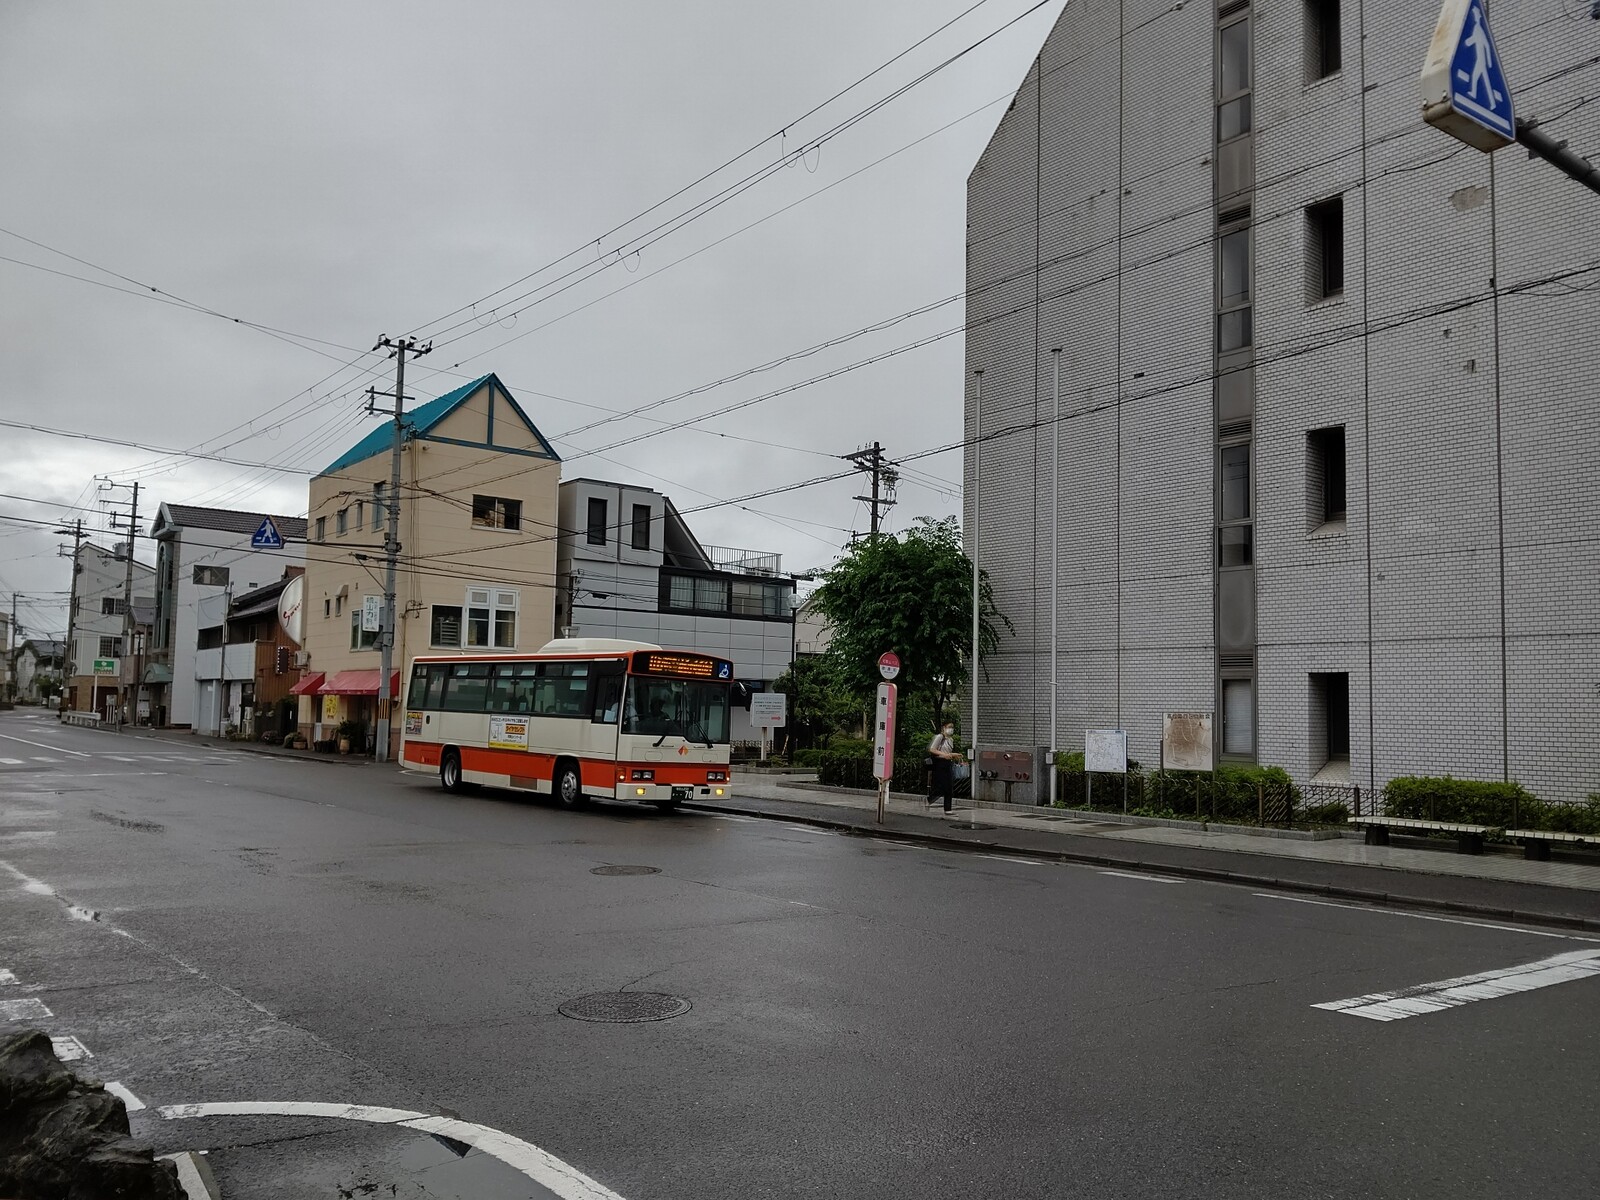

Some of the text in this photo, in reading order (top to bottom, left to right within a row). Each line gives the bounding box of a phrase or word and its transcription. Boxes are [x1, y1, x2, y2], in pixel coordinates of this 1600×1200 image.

[877, 696, 887, 756] 車庫前
[684, 790, 693, 799] 70
